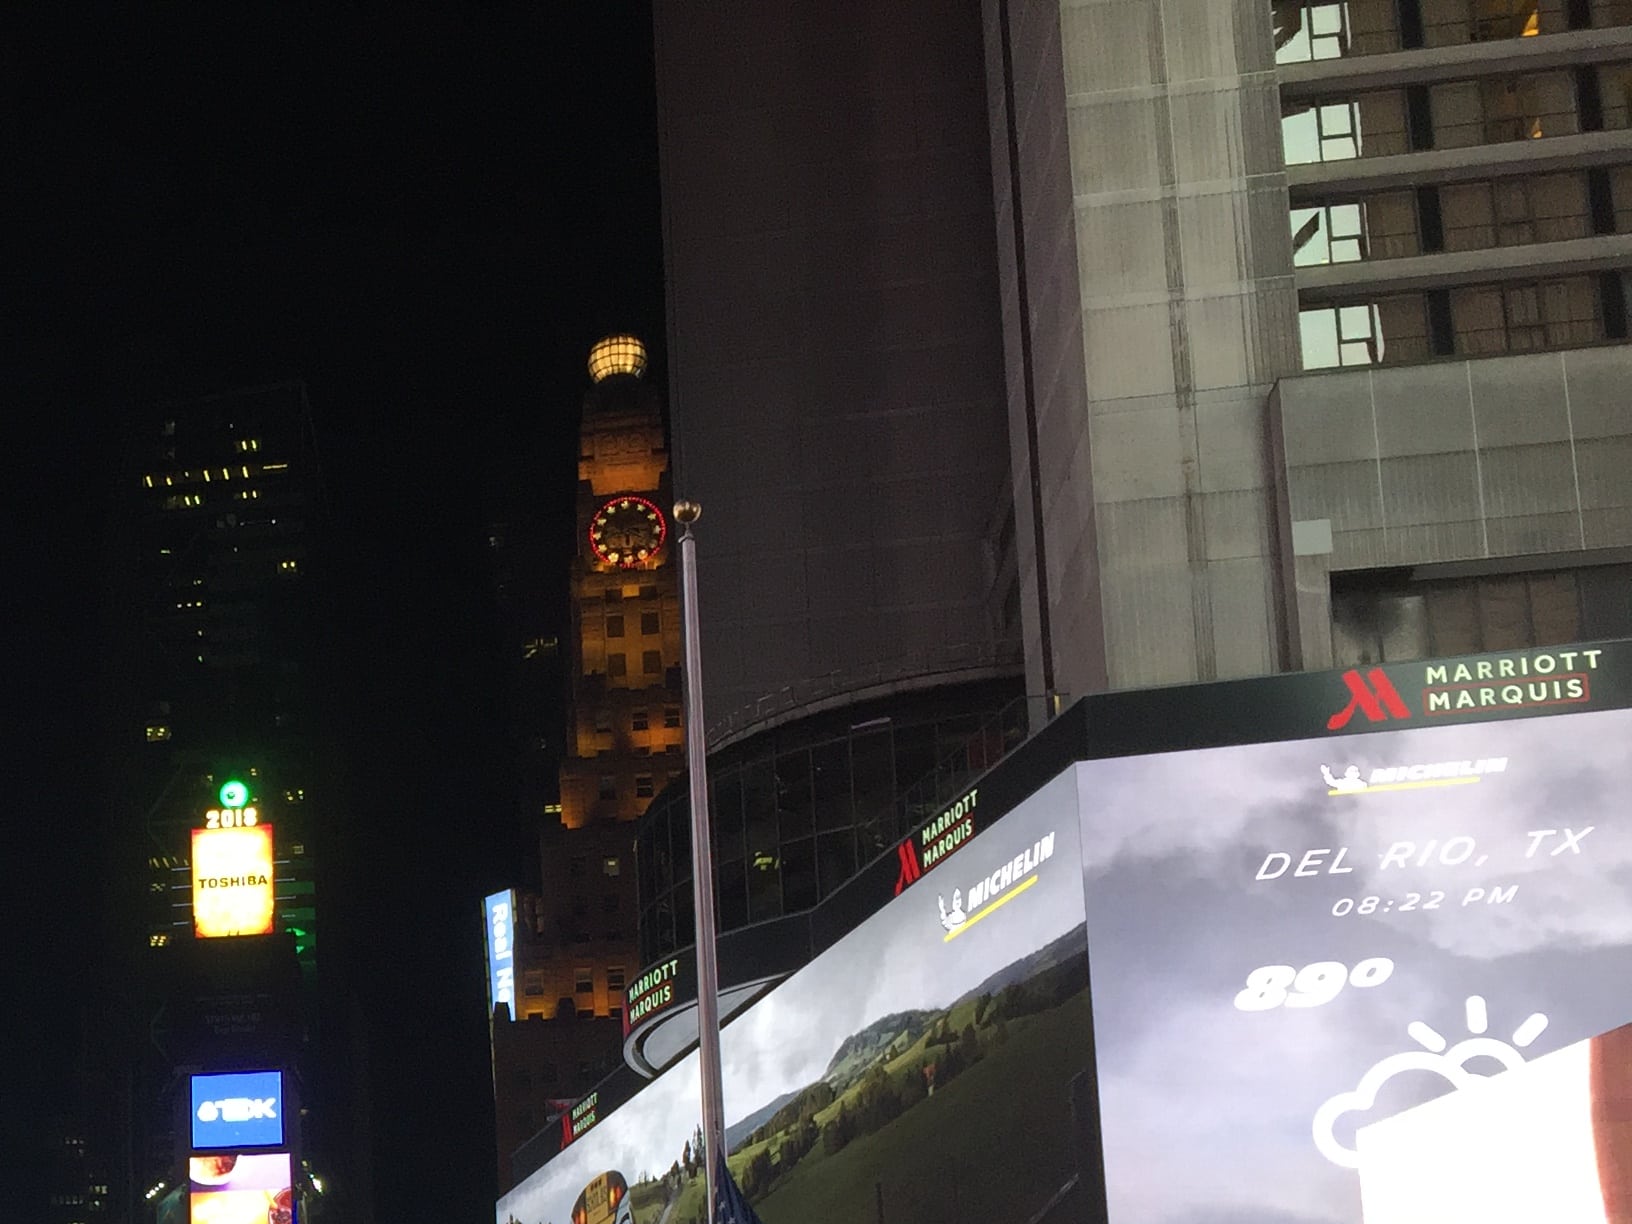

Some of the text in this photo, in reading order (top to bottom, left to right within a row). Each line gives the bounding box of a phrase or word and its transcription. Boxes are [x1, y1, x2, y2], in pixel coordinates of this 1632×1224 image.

[1426, 650, 1602, 685] MARRIOTT
[1428, 679, 1584, 712] MARQUIS
[1369, 758, 1508, 784] MICHELIN
[206, 808, 258, 828] 2018
[921, 790, 979, 846] MARRIOTT
[923, 818, 972, 867] MARQUIS
[1256, 826, 1594, 881] DEL RIO, TX
[198, 875, 268, 890] TOSHIBA
[967, 832, 1055, 912] MICHELIN
[1332, 885, 1519, 916] 08:22 PM
[492, 902, 511, 960] Real
[629, 960, 679, 1004] MARRIOTT
[629, 985, 672, 1024] MARQUIS
